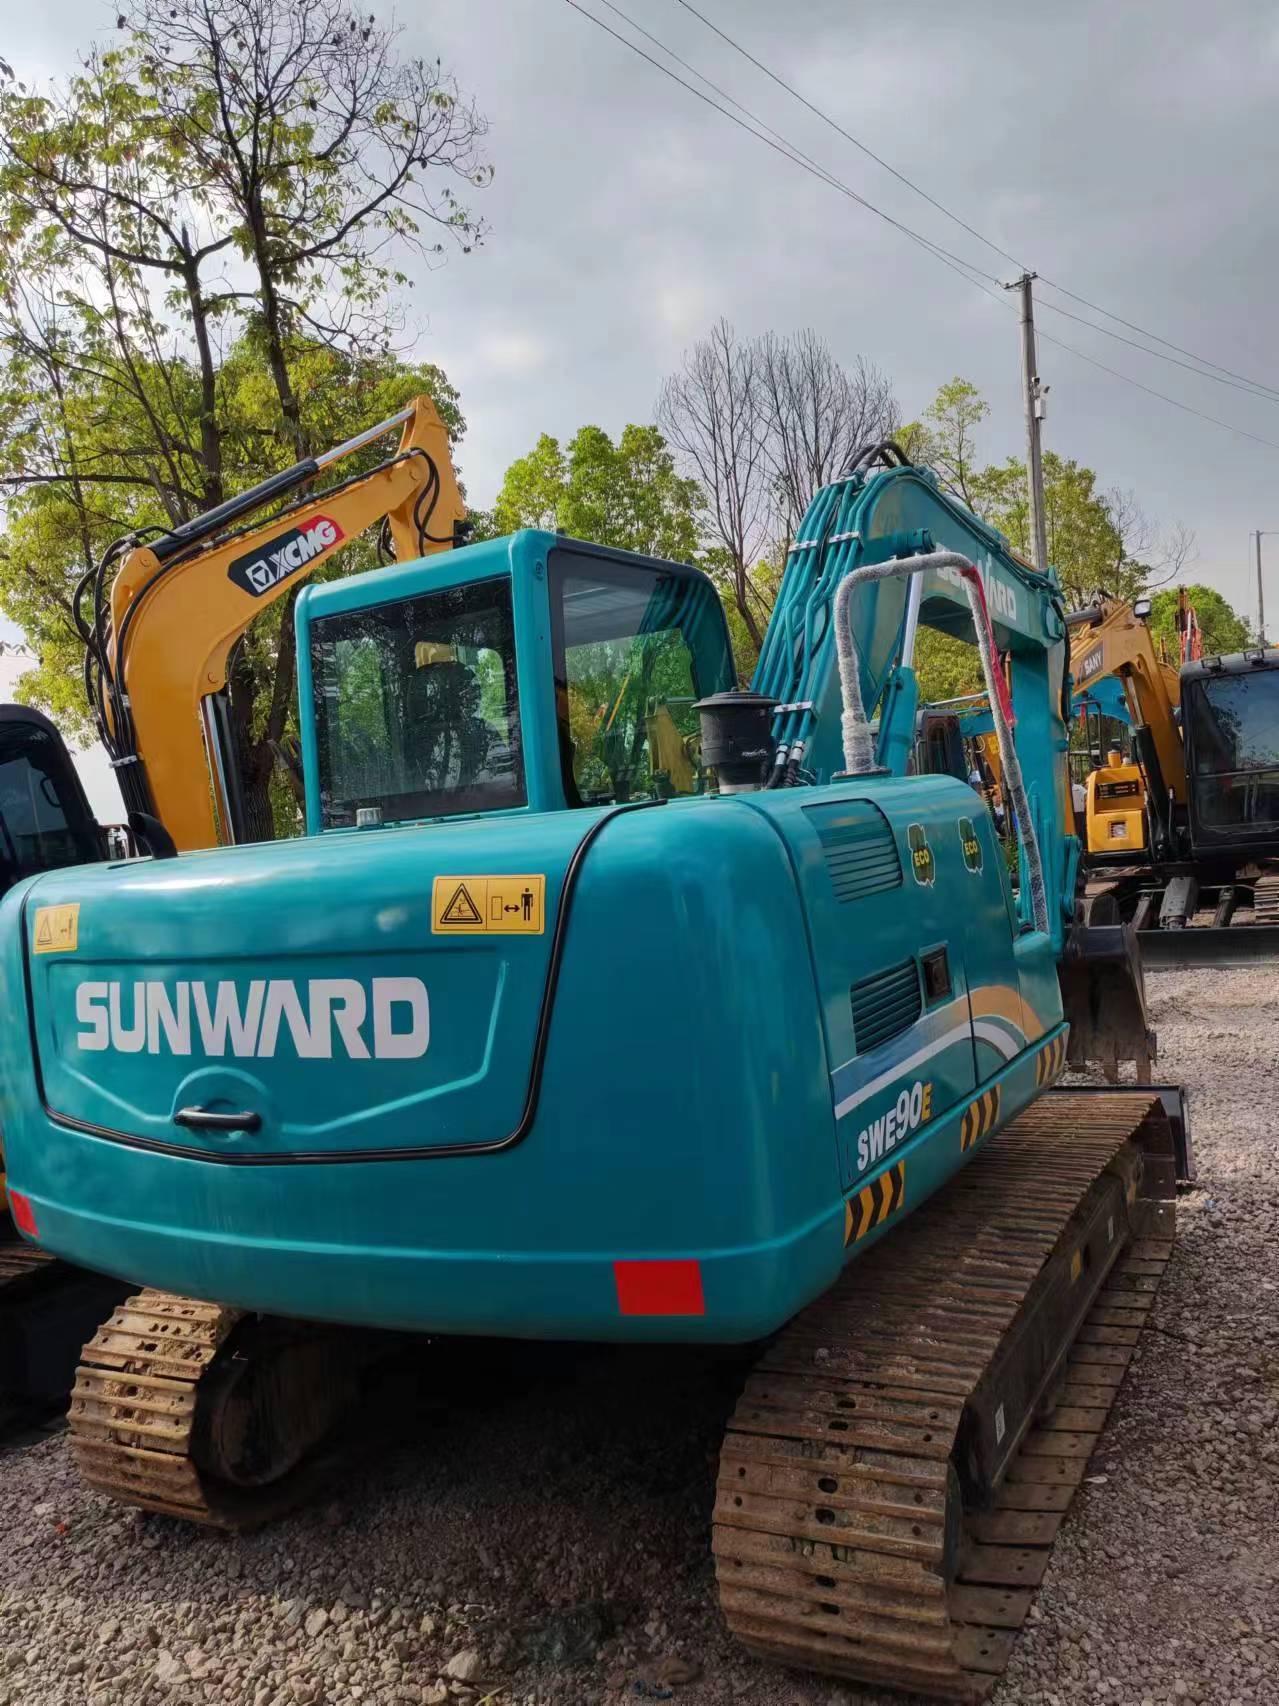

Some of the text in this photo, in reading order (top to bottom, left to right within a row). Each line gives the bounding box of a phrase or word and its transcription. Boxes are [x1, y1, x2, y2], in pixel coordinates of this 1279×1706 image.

[269, 520, 337, 581] XCMG
[1084, 650, 1102, 676] SANY
[914, 849, 930, 867] ECO
[964, 840, 978, 856] ECO
[76, 977, 430, 1059] SUNWARD
[857, 1081, 933, 1171] SWE90E
